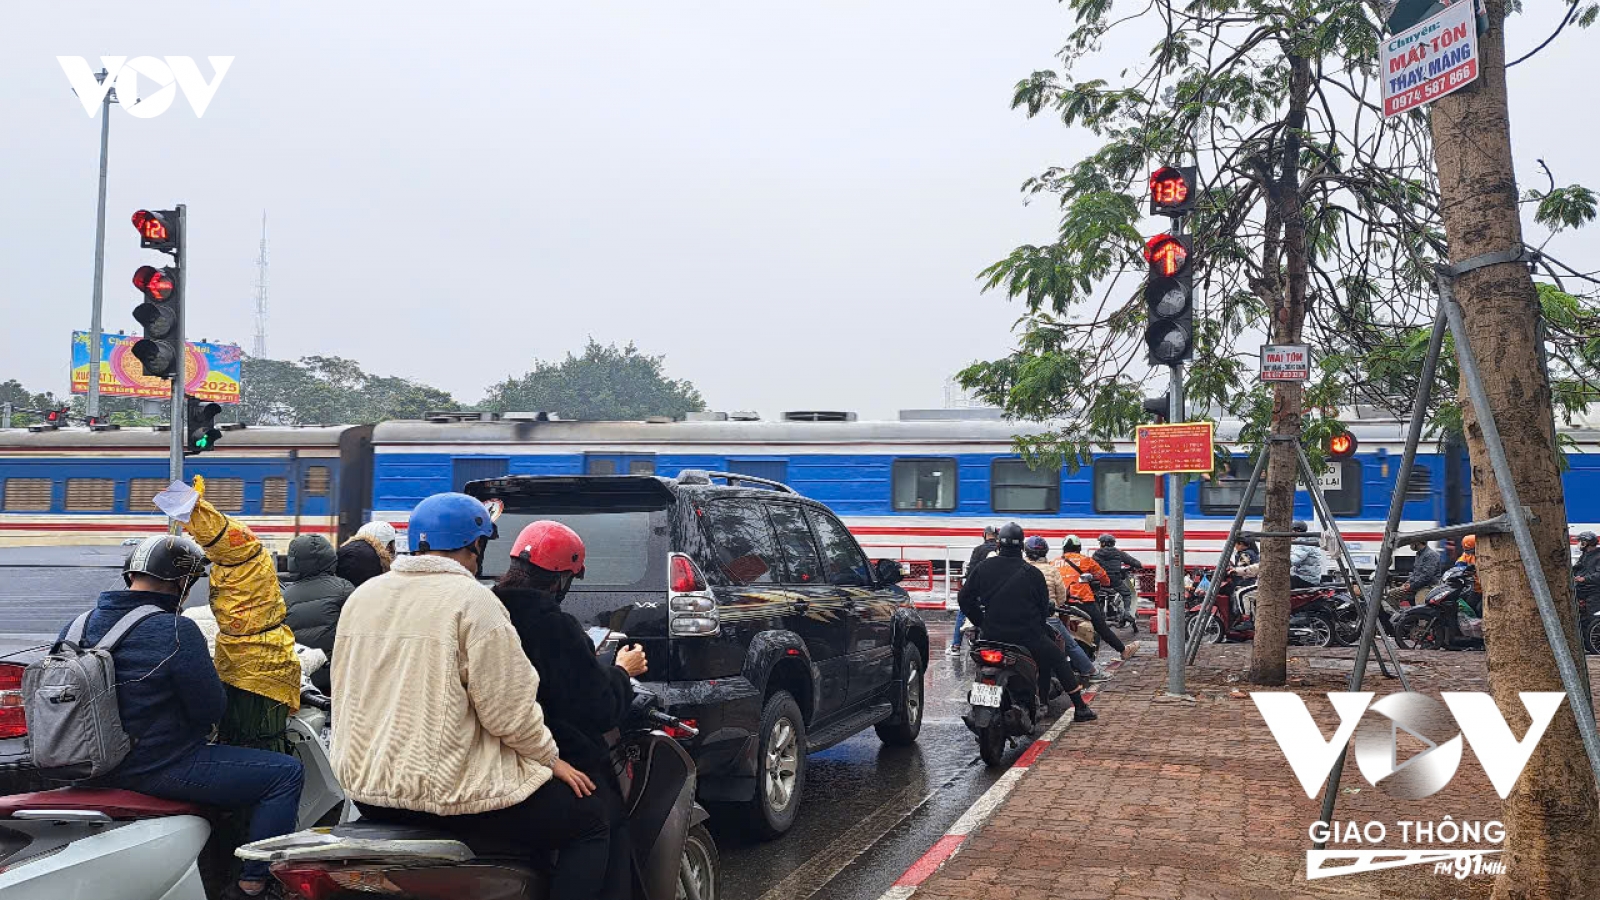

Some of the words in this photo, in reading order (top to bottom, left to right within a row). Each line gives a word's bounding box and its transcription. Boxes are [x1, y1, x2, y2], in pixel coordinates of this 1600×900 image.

[1389, 44, 1427, 74] MÁI
[1430, 22, 1467, 53] TÔN
[1389, 66, 1424, 94] THAY
[1428, 43, 1471, 77] MÁNG
[1392, 90, 1422, 110] 0974
[1424, 77, 1446, 97] 587
[1449, 66, 1470, 85] 866
[200, 381, 237, 392] 2025
